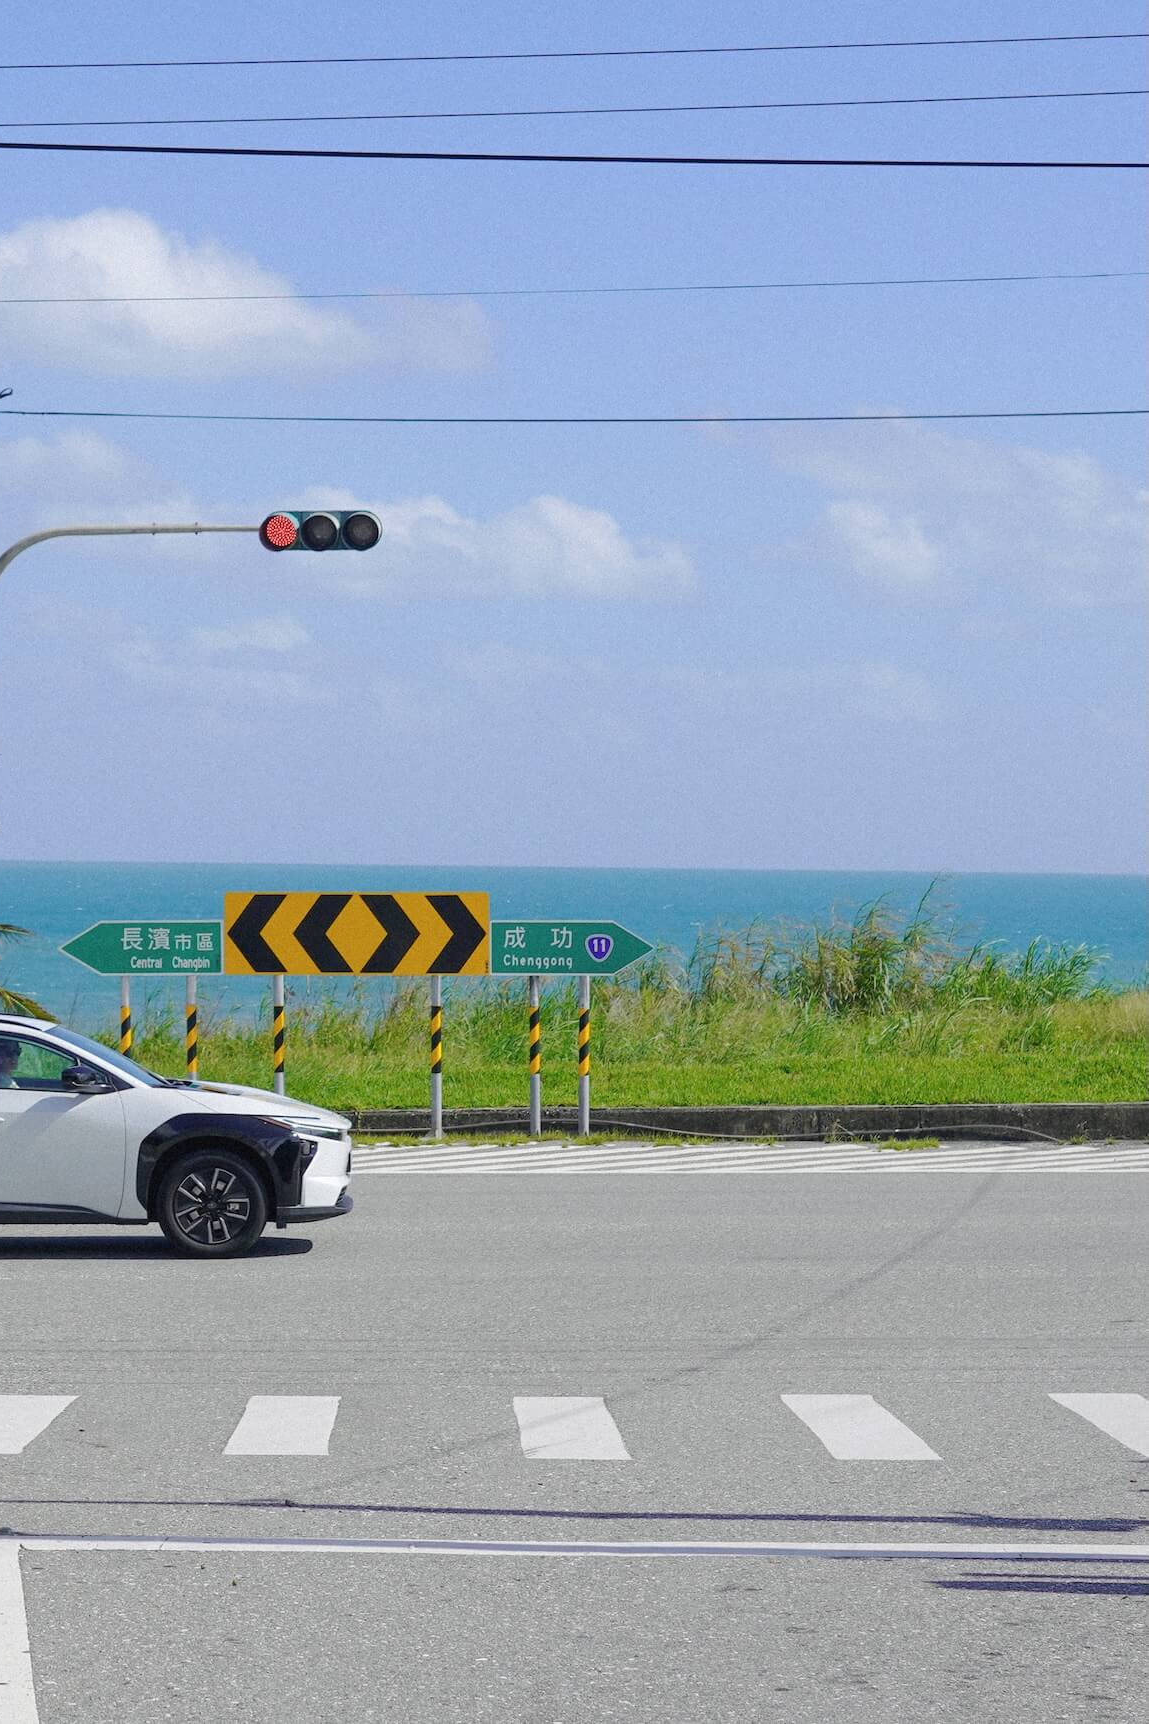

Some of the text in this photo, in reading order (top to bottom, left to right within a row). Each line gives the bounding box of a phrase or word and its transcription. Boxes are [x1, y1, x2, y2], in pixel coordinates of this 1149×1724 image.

[121, 928, 214, 950] 長濱市區
[504, 926, 573, 948] 成功
[593, 939, 606, 952] 11
[130, 957, 210, 971] Central Changbin
[503, 954, 573, 970] Chenggong
